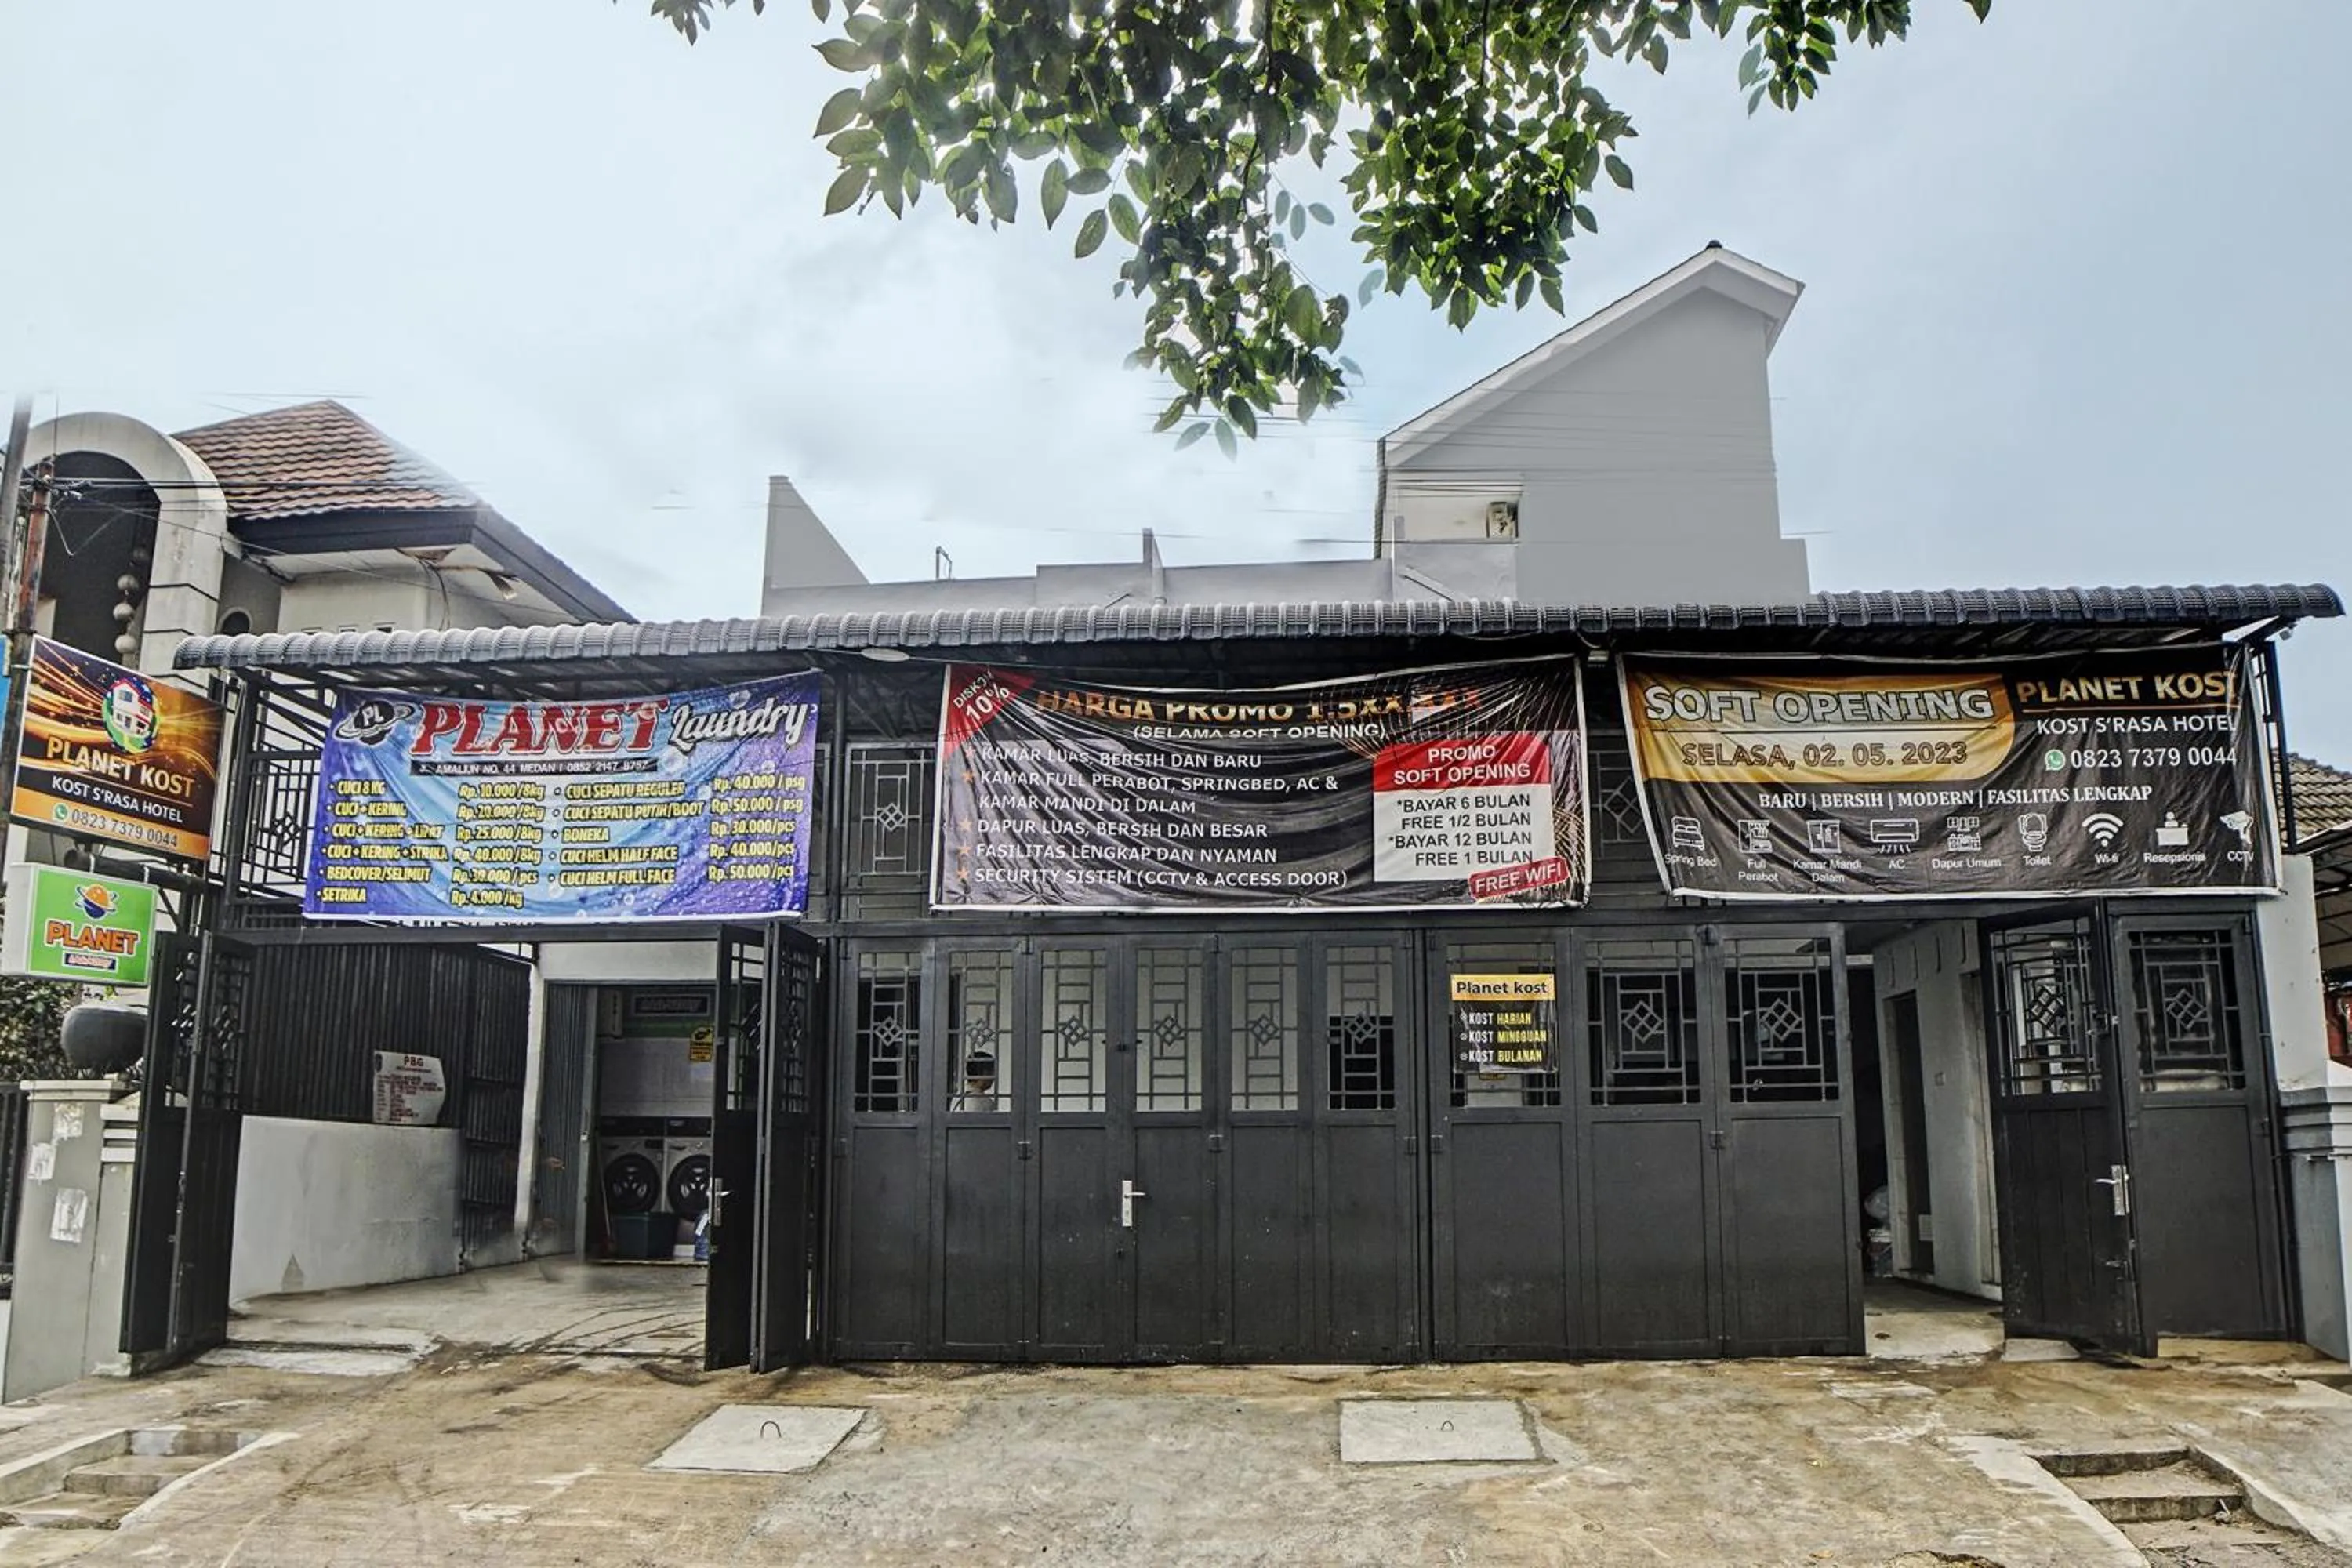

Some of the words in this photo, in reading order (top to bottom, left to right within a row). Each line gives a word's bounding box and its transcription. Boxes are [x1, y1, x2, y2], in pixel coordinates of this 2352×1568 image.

[2016, 676, 2143, 703] PLANET
[2155, 670, 2238, 699] KOST
[1036, 690, 1155, 720] HARGA
[1166, 702, 1293, 722] PROMO
[1645, 685, 1760, 723] SOFT
[1773, 688, 1995, 724] OPENING
[364, 704, 383, 726] PL
[411, 699, 669, 755] PLANET
[670, 697, 808, 753] Laundry
[1133, 724, 1224, 739] (SELAMA
[1289, 723, 1385, 740] OPENING)
[2038, 718, 2089, 735] KOST
[2096, 717, 2168, 733] S'RASA
[2173, 714, 2236, 731] HOTEL
[982, 746, 1040, 761] KAMAR
[1047, 748, 1093, 765] LUAS,
[1100, 753, 1164, 767] BERSIH
[1171, 754, 1207, 768] DAN
[1214, 754, 1261, 768] BARU
[1428, 745, 1496, 763] PROMO
[1681, 743, 1795, 771] SELASA,
[1803, 743, 1844, 766] 02.
[1852, 743, 1893, 766] 05.
[1901, 741, 1968, 765] 2023
[2071, 750, 2122, 768] 0823
[2129, 748, 2180, 767] 7379
[2188, 747, 2237, 766] 0044
[47, 736, 135, 781] PLANET
[140, 764, 195, 797] KOST
[521, 763, 555, 773] MEDAN
[1394, 768, 1442, 785] SOFT
[1448, 763, 1531, 782] OPENING
[566, 785, 590, 798] CUCI
[594, 784, 633, 797] SEPATU
[981, 771, 1040, 785] KAMAR
[1046, 772, 1085, 786] FULL
[1092, 774, 1175, 793] PERABOT,
[1181, 777, 1290, 793] SPRINGBED,
[1297, 777, 1319, 790] AC
[1325, 776, 1338, 790] &
[52, 776, 89, 797] KOST
[93, 787, 139, 811] S'RASA
[142, 801, 183, 822] HOTEL
[979, 795, 1038, 809] KAMAR
[1044, 797, 1104, 811] MANDI
[1110, 798, 1130, 812] DI
[1136, 798, 1196, 813] DALAM
[1461, 796, 1469, 809] 6
[1475, 793, 1531, 809] BULAN
[1759, 793, 1806, 808] BARU
[1821, 792, 1884, 808] BERSIH
[1897, 790, 1974, 807] MODERN
[1988, 787, 2070, 804] FASILITAS
[2074, 786, 2153, 801] LENGKAP
[564, 805, 589, 819] CUCI
[591, 805, 633, 818] SEPATU
[1402, 815, 1443, 830] FREE
[1449, 815, 1471, 828] 1/2
[1476, 812, 1531, 827] BULAN
[71, 808, 106, 829] 0823
[111, 818, 143, 839] 7379
[147, 827, 178, 848] 0044
[564, 828, 608, 841] BONEKA
[978, 819, 1036, 833] DAPUR
[1042, 820, 1090, 837] LUAS,
[1097, 822, 1161, 837] BERSIH
[1167, 823, 1204, 837] DAN
[1210, 824, 1268, 837] BESAR
[1454, 833, 1472, 846] 12
[1476, 831, 1532, 845] BULAN
[561, 849, 586, 863] CUCI
[588, 849, 619, 862] HELM
[621, 848, 649, 862] HALF
[651, 847, 677, 860] FACE
[976, 844, 1065, 859] FASILITAS
[1071, 845, 1151, 860] LENGKAP
[1156, 848, 1194, 862] DAN
[1200, 848, 1277, 863] NYAMAN
[1415, 852, 1458, 866] FREE
[1465, 852, 1471, 865] 1
[1477, 850, 1533, 863] BULAN
[2023, 855, 2051, 866] Toilet
[2227, 851, 2254, 862] CCTV
[1793, 859, 1827, 869] Kamar
[1830, 858, 1862, 869] Mandi
[1889, 858, 1905, 869] AC
[1931, 858, 1963, 870] Dapur
[1966, 858, 2002, 868] Umum
[561, 871, 585, 885] CUCI
[588, 871, 617, 884] HELM
[618, 869, 645, 884] FULL
[648, 869, 675, 883] FACE
[975, 869, 1060, 884] SECURITY
[1065, 869, 1131, 885] SISTEM
[1138, 870, 1190, 887] (CCTV
[1196, 873, 1208, 886] &
[1214, 873, 1282, 886] ACCESS
[1288, 871, 1348, 888] DOOR)
[1475, 872, 1521, 893] FREE
[1525, 862, 1562, 884] WIFI
[1738, 871, 1778, 882] Perabot
[1812, 873, 1844, 882] Dalam
[46, 919, 139, 955] PLANET
[1457, 982, 1509, 993] Planet
[1514, 982, 1548, 993] kost
[1468, 1012, 1493, 1025] KOST
[1468, 1030, 1493, 1044] KOST
[1468, 1049, 1494, 1062] KOST
[1497, 1049, 1542, 1062] BULANAN
